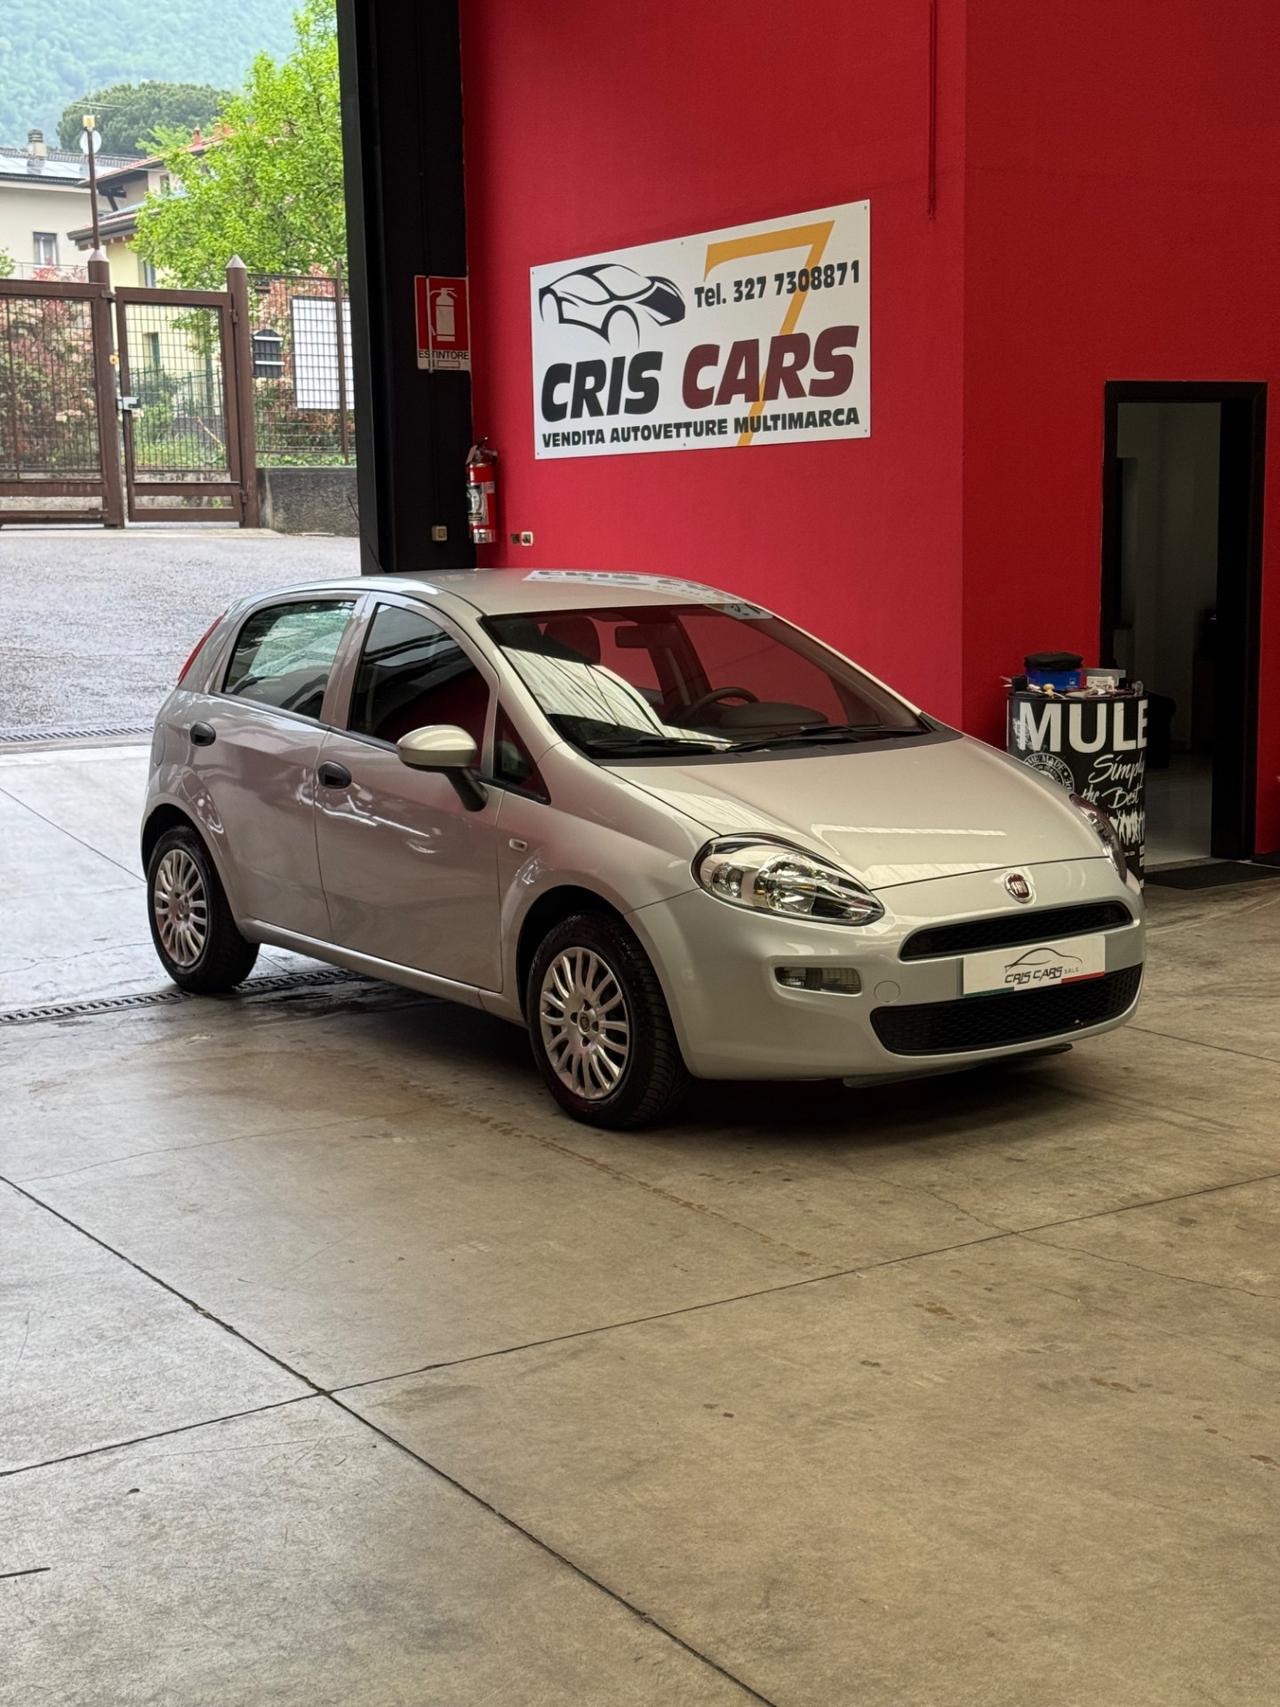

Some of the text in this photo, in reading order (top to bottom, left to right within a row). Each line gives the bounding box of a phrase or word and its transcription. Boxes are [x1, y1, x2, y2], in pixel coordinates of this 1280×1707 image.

[694, 259, 859, 308] Tel. 327 7308871
[418, 351, 470, 360] ESTINTORE
[541, 325, 859, 423] CRIS CARS
[542, 407, 860, 448] VENDITA AUTOVETTURE MULTIMARCA
[1101, 784, 1143, 809] Best
[1005, 971, 1031, 984] CRIS
[1033, 966, 1063, 981] CARS
